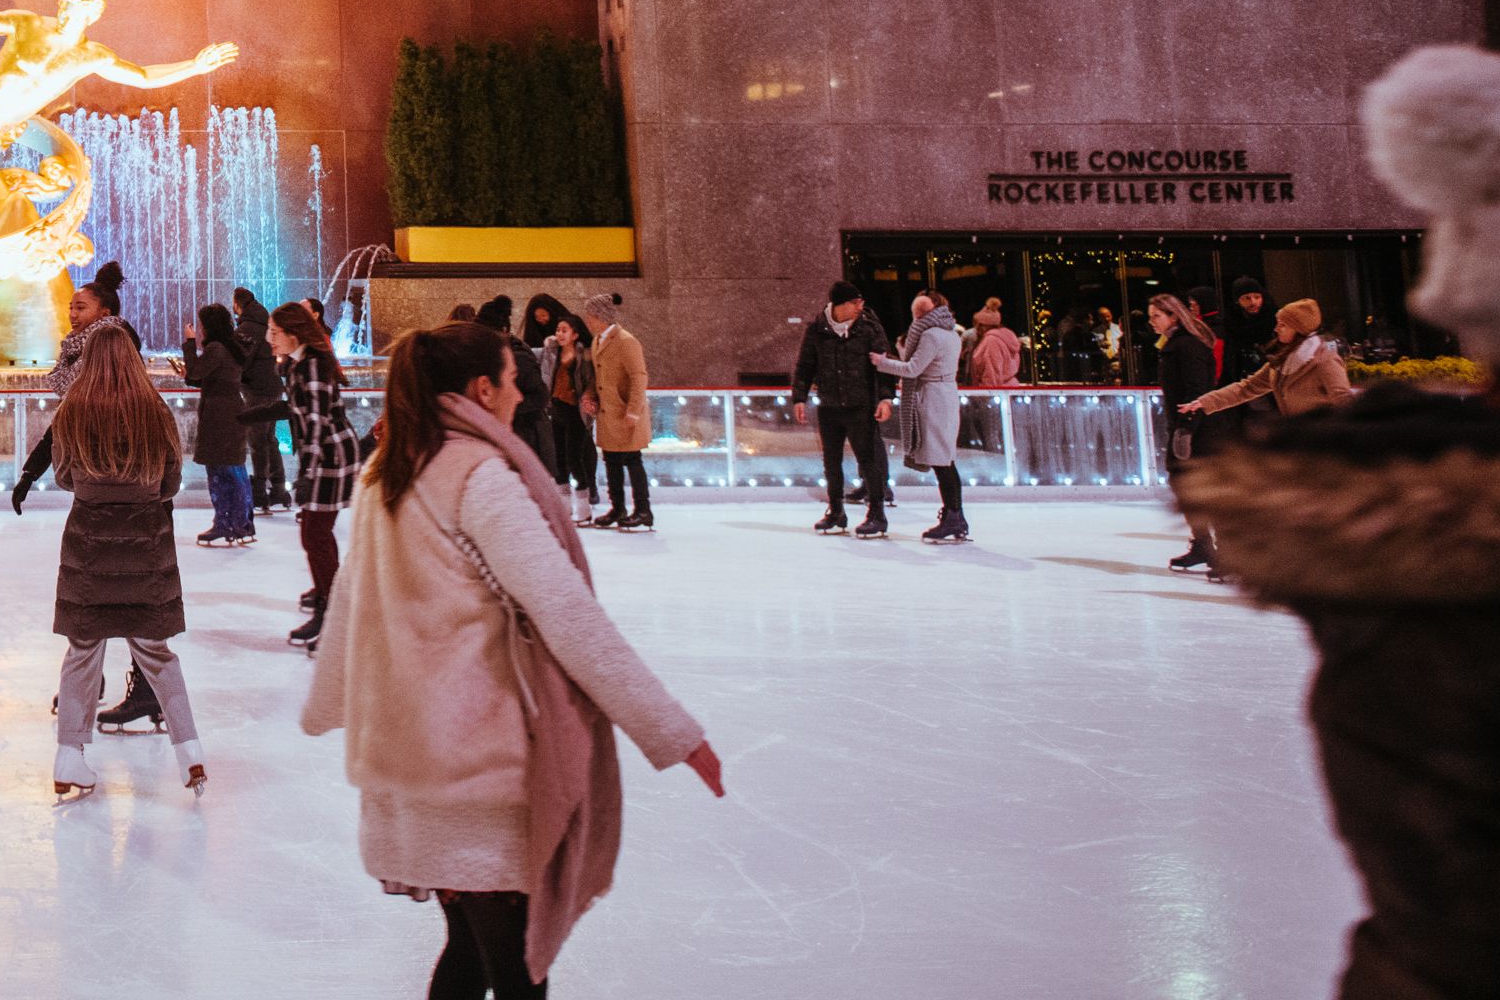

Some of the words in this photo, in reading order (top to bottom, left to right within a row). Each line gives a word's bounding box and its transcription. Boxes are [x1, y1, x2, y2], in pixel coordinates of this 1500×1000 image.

[1032, 150, 1080, 172] THE
[1088, 150, 1248, 172] CONCOURSE
[987, 181, 1177, 204] ROCKEFELLER
[1188, 181, 1295, 203] CENTER
